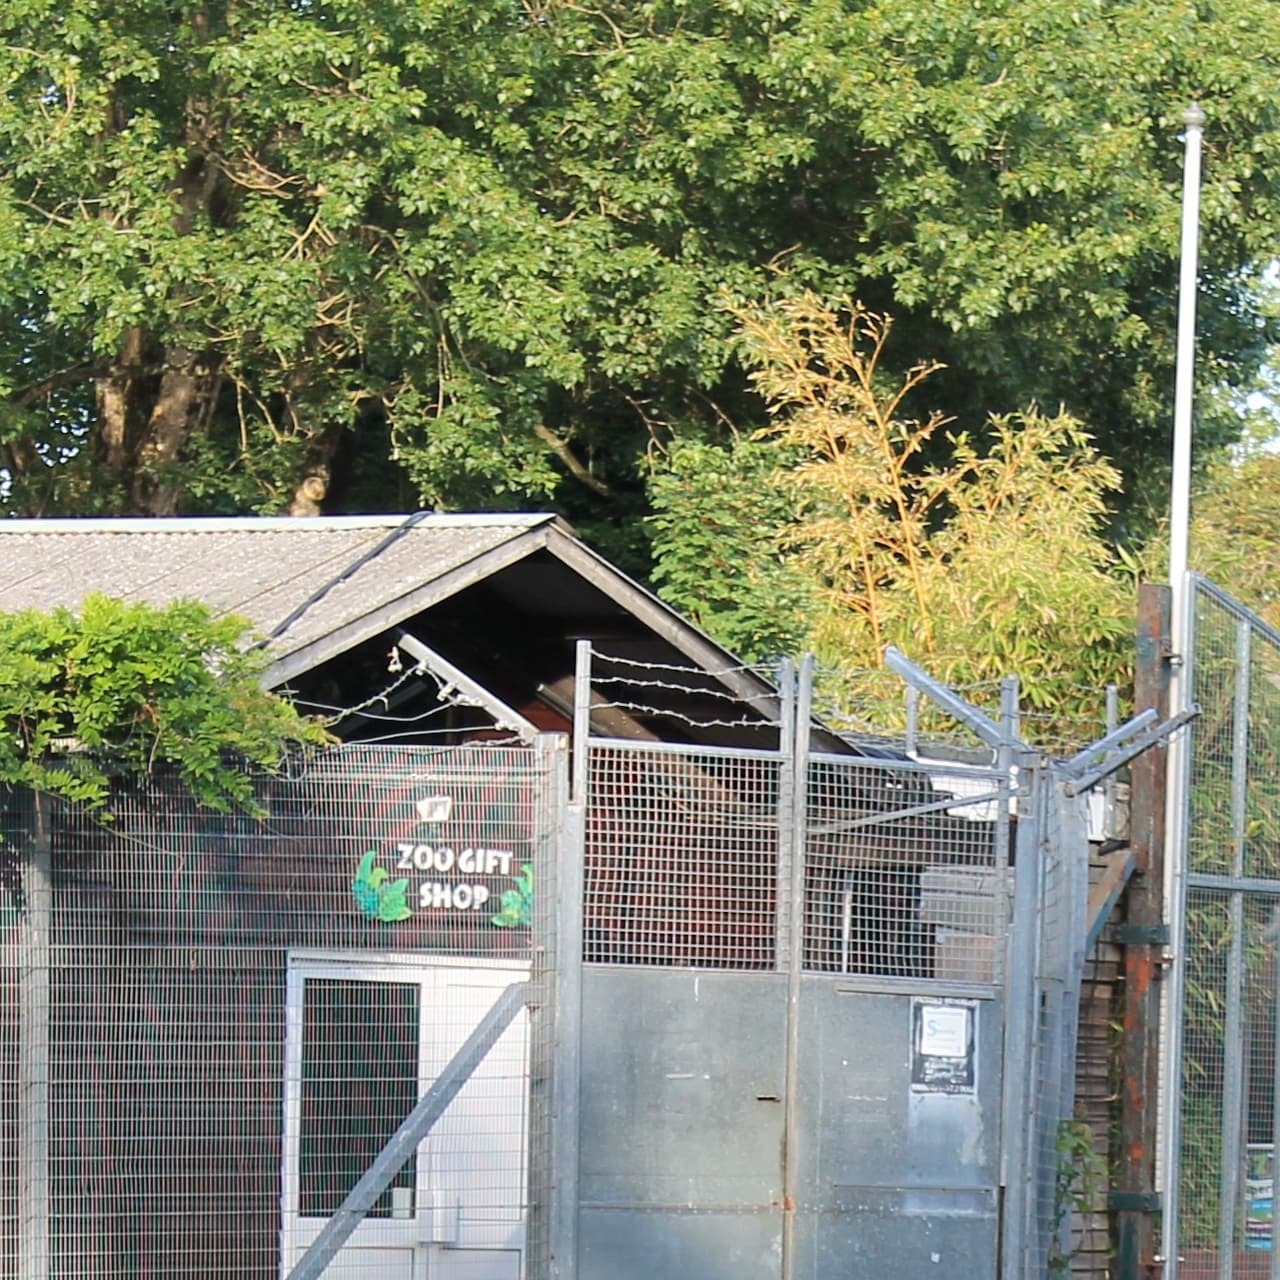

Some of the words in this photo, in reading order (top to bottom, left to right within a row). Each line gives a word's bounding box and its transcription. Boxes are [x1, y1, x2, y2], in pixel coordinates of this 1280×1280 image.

[397, 843, 455, 872] ZOO
[458, 848, 513, 875] GIFT
[420, 881, 490, 910] SHOP
